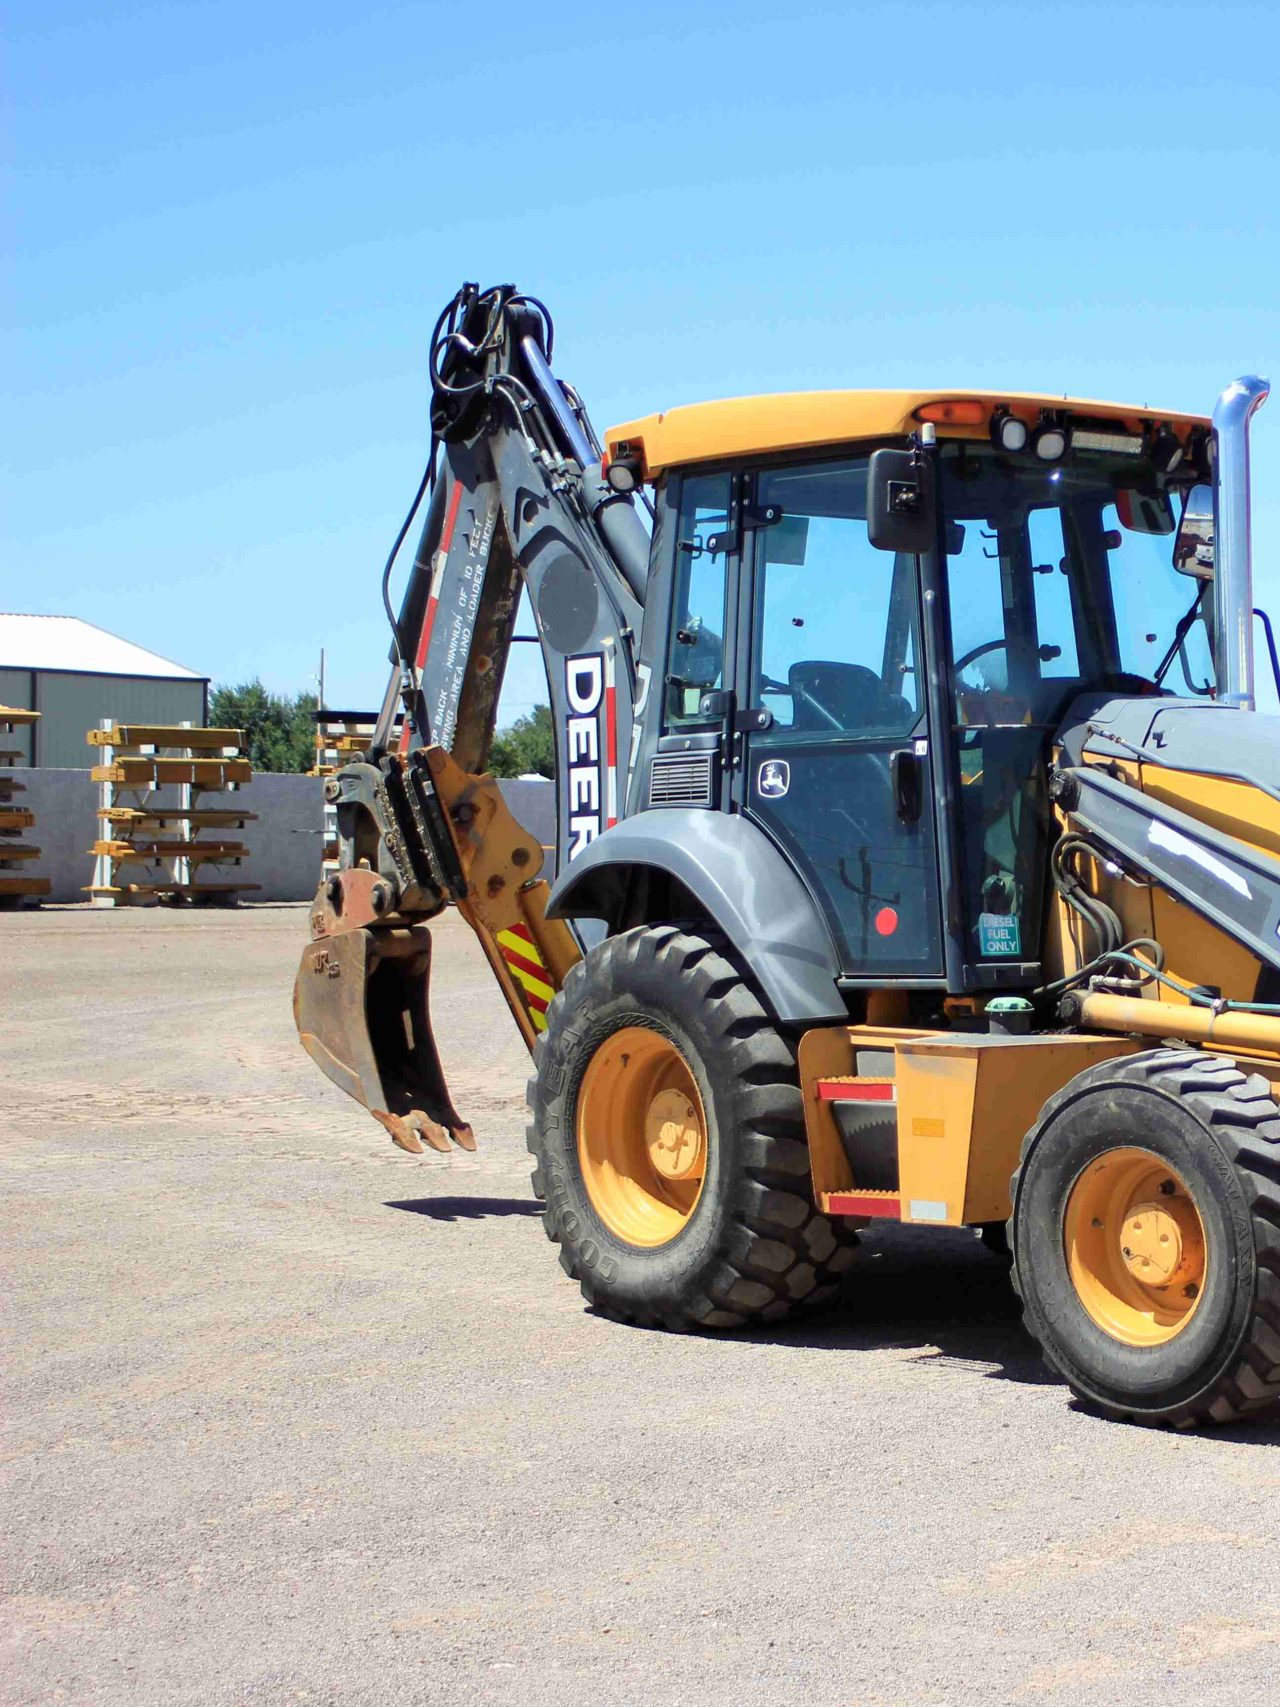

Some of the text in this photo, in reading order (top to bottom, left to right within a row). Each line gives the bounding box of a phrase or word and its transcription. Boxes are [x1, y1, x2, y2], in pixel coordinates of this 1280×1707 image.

[468, 518, 482, 557] FEET
[464, 565, 473, 579] 10
[458, 586, 468, 607] OF
[440, 709, 454, 751] SWING
[450, 666, 463, 703] AREA
[460, 627, 471, 656] AND
[466, 564, 484, 621] LOADER
[446, 613, 463, 669] MINIMUM
[434, 688, 448, 726] BACK
[565, 652, 604, 863] DEER
[983, 916, 1015, 928] DIESEL
[987, 928, 1011, 939] FUEL
[986, 940, 1017, 952] ONLY
[541, 995, 619, 1285] GOODYEAR
